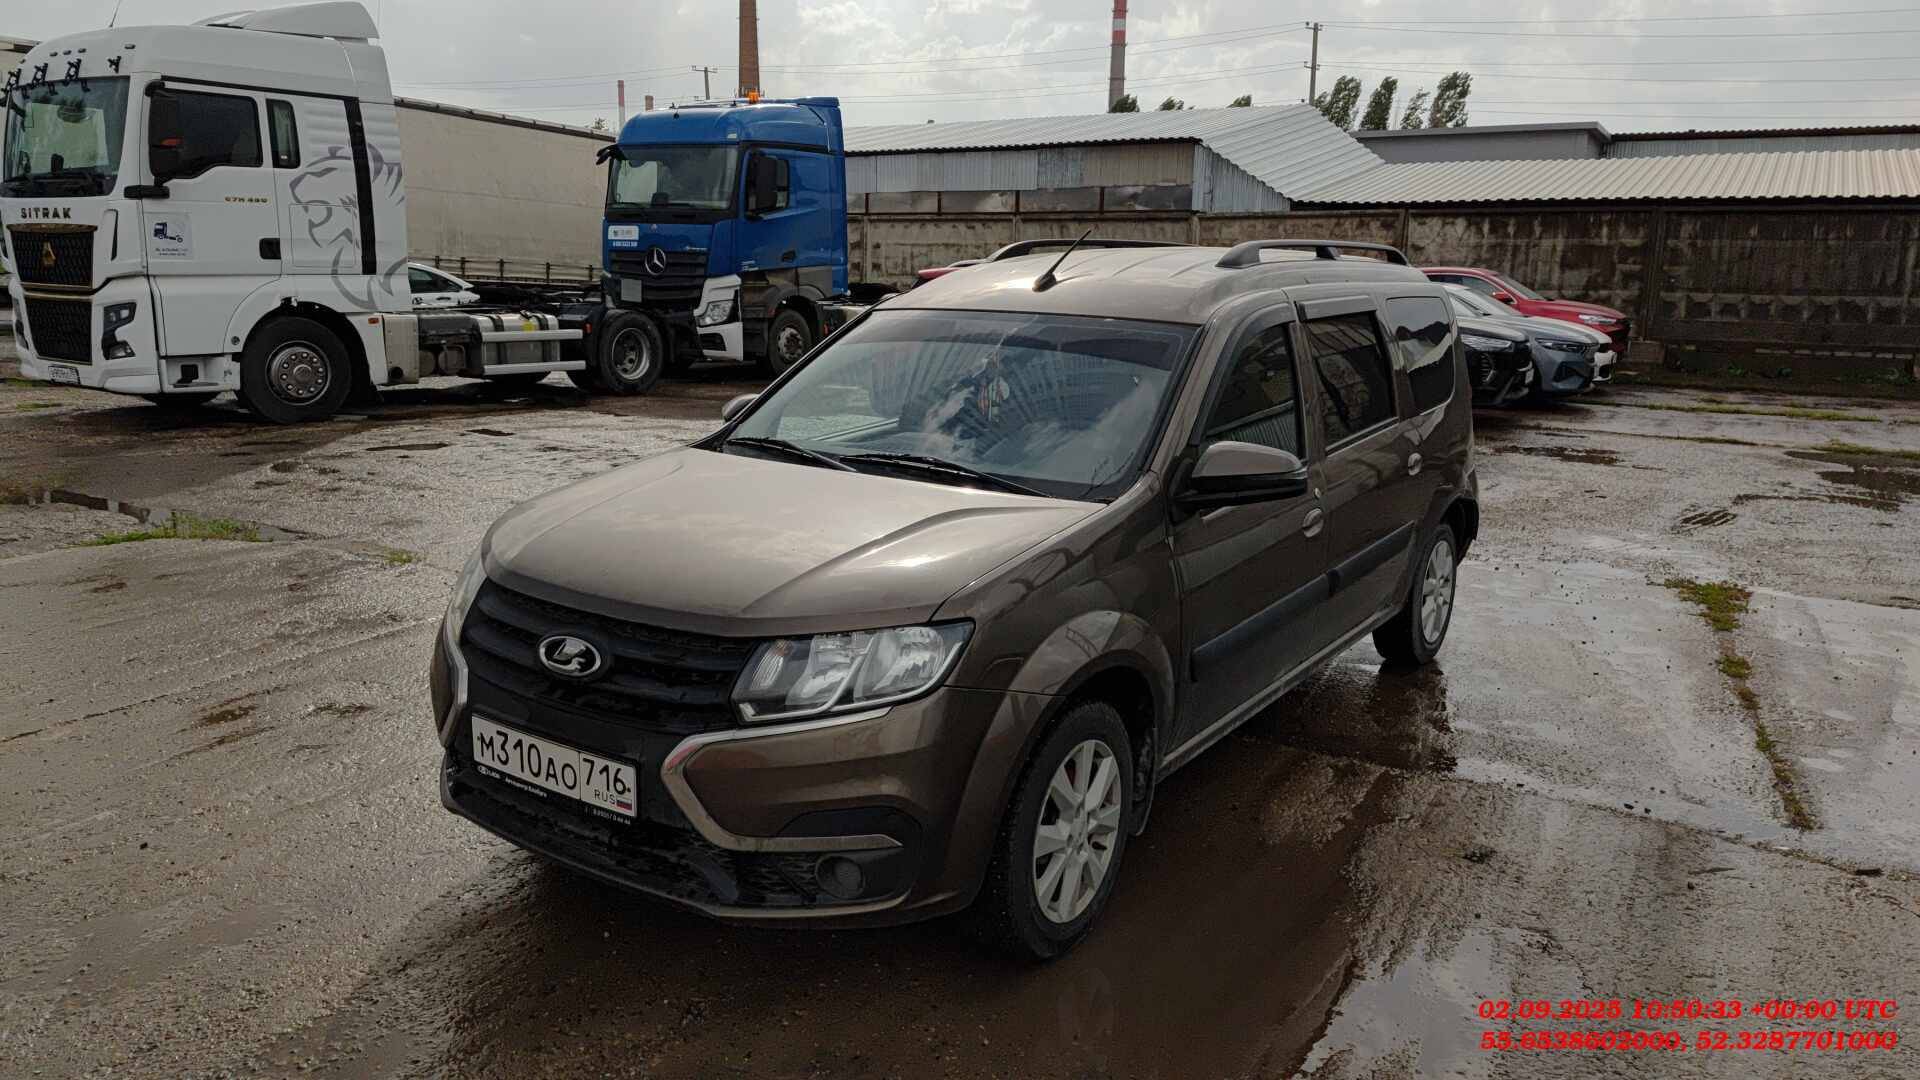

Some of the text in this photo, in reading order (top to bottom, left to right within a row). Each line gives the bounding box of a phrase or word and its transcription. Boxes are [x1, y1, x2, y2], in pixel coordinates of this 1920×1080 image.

[21, 207, 71, 219] SITRAK
[479, 730, 578, 790] М310АО
[582, 757, 627, 795] 716
[594, 789, 616, 805] RUS
